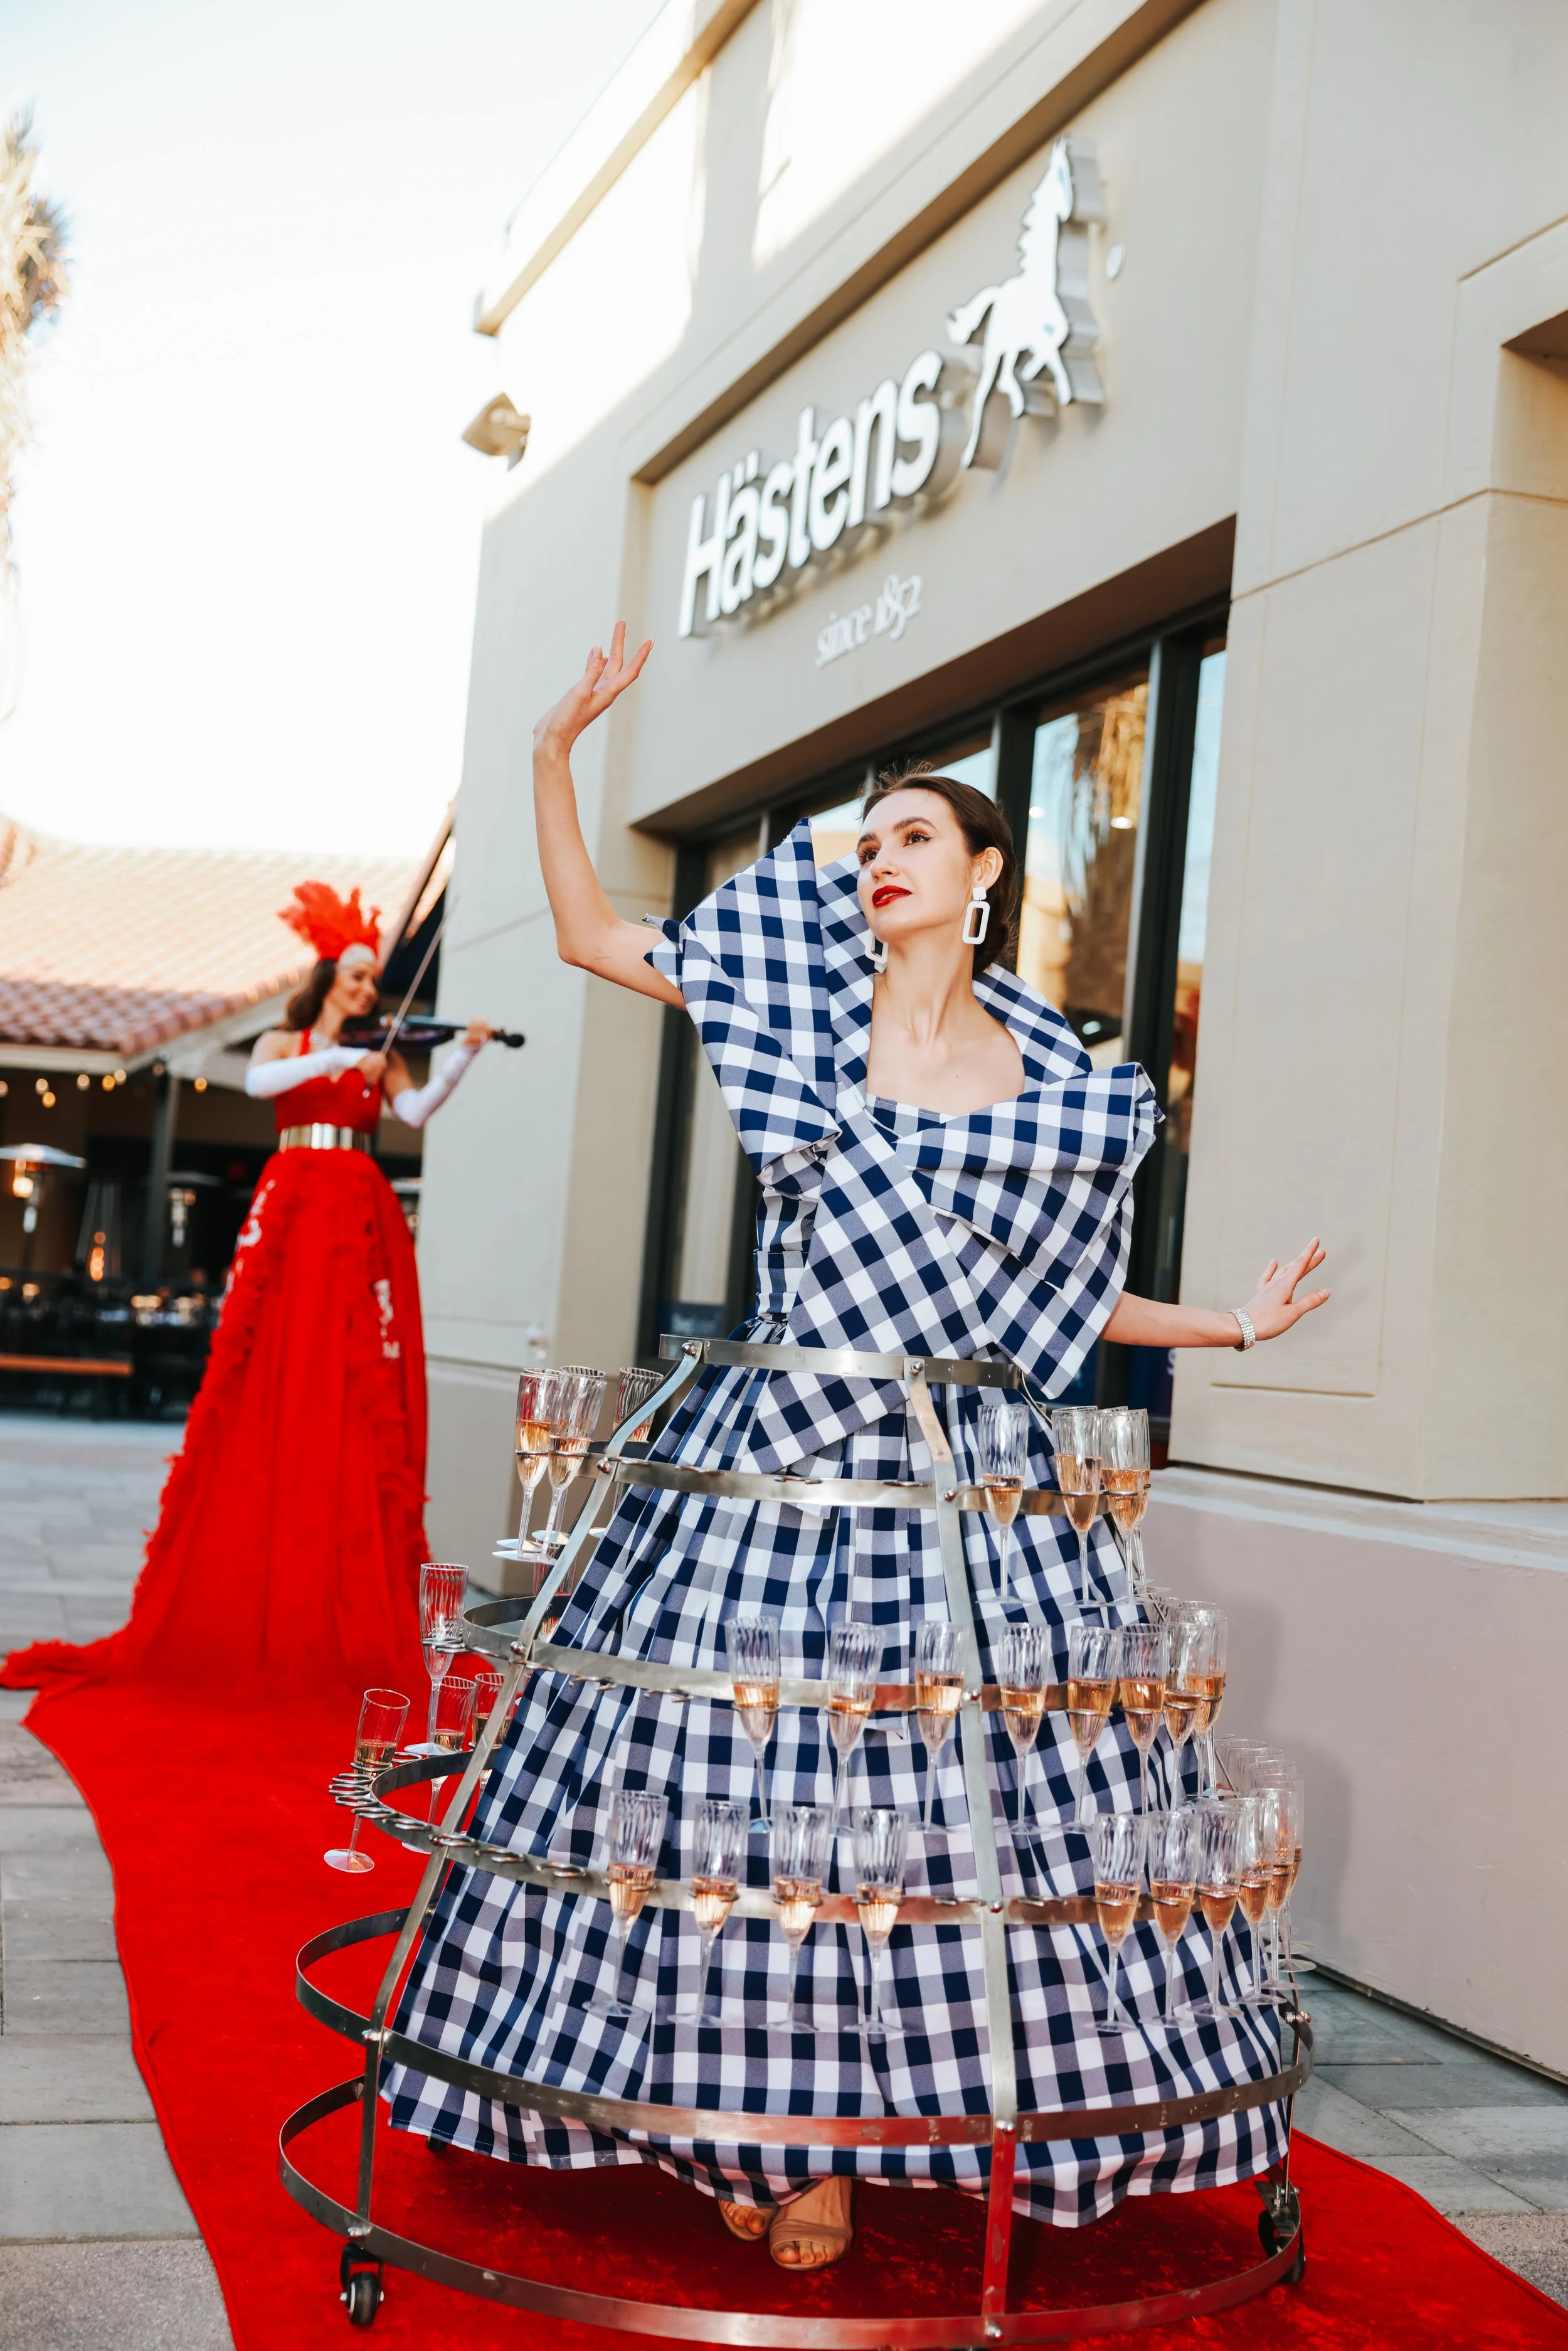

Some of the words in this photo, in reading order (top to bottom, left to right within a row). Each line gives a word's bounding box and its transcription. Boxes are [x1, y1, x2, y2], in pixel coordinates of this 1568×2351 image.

[679, 349, 943, 639] Hästens
[815, 604, 872, 667] since
[874, 574, 921, 640] 1852
